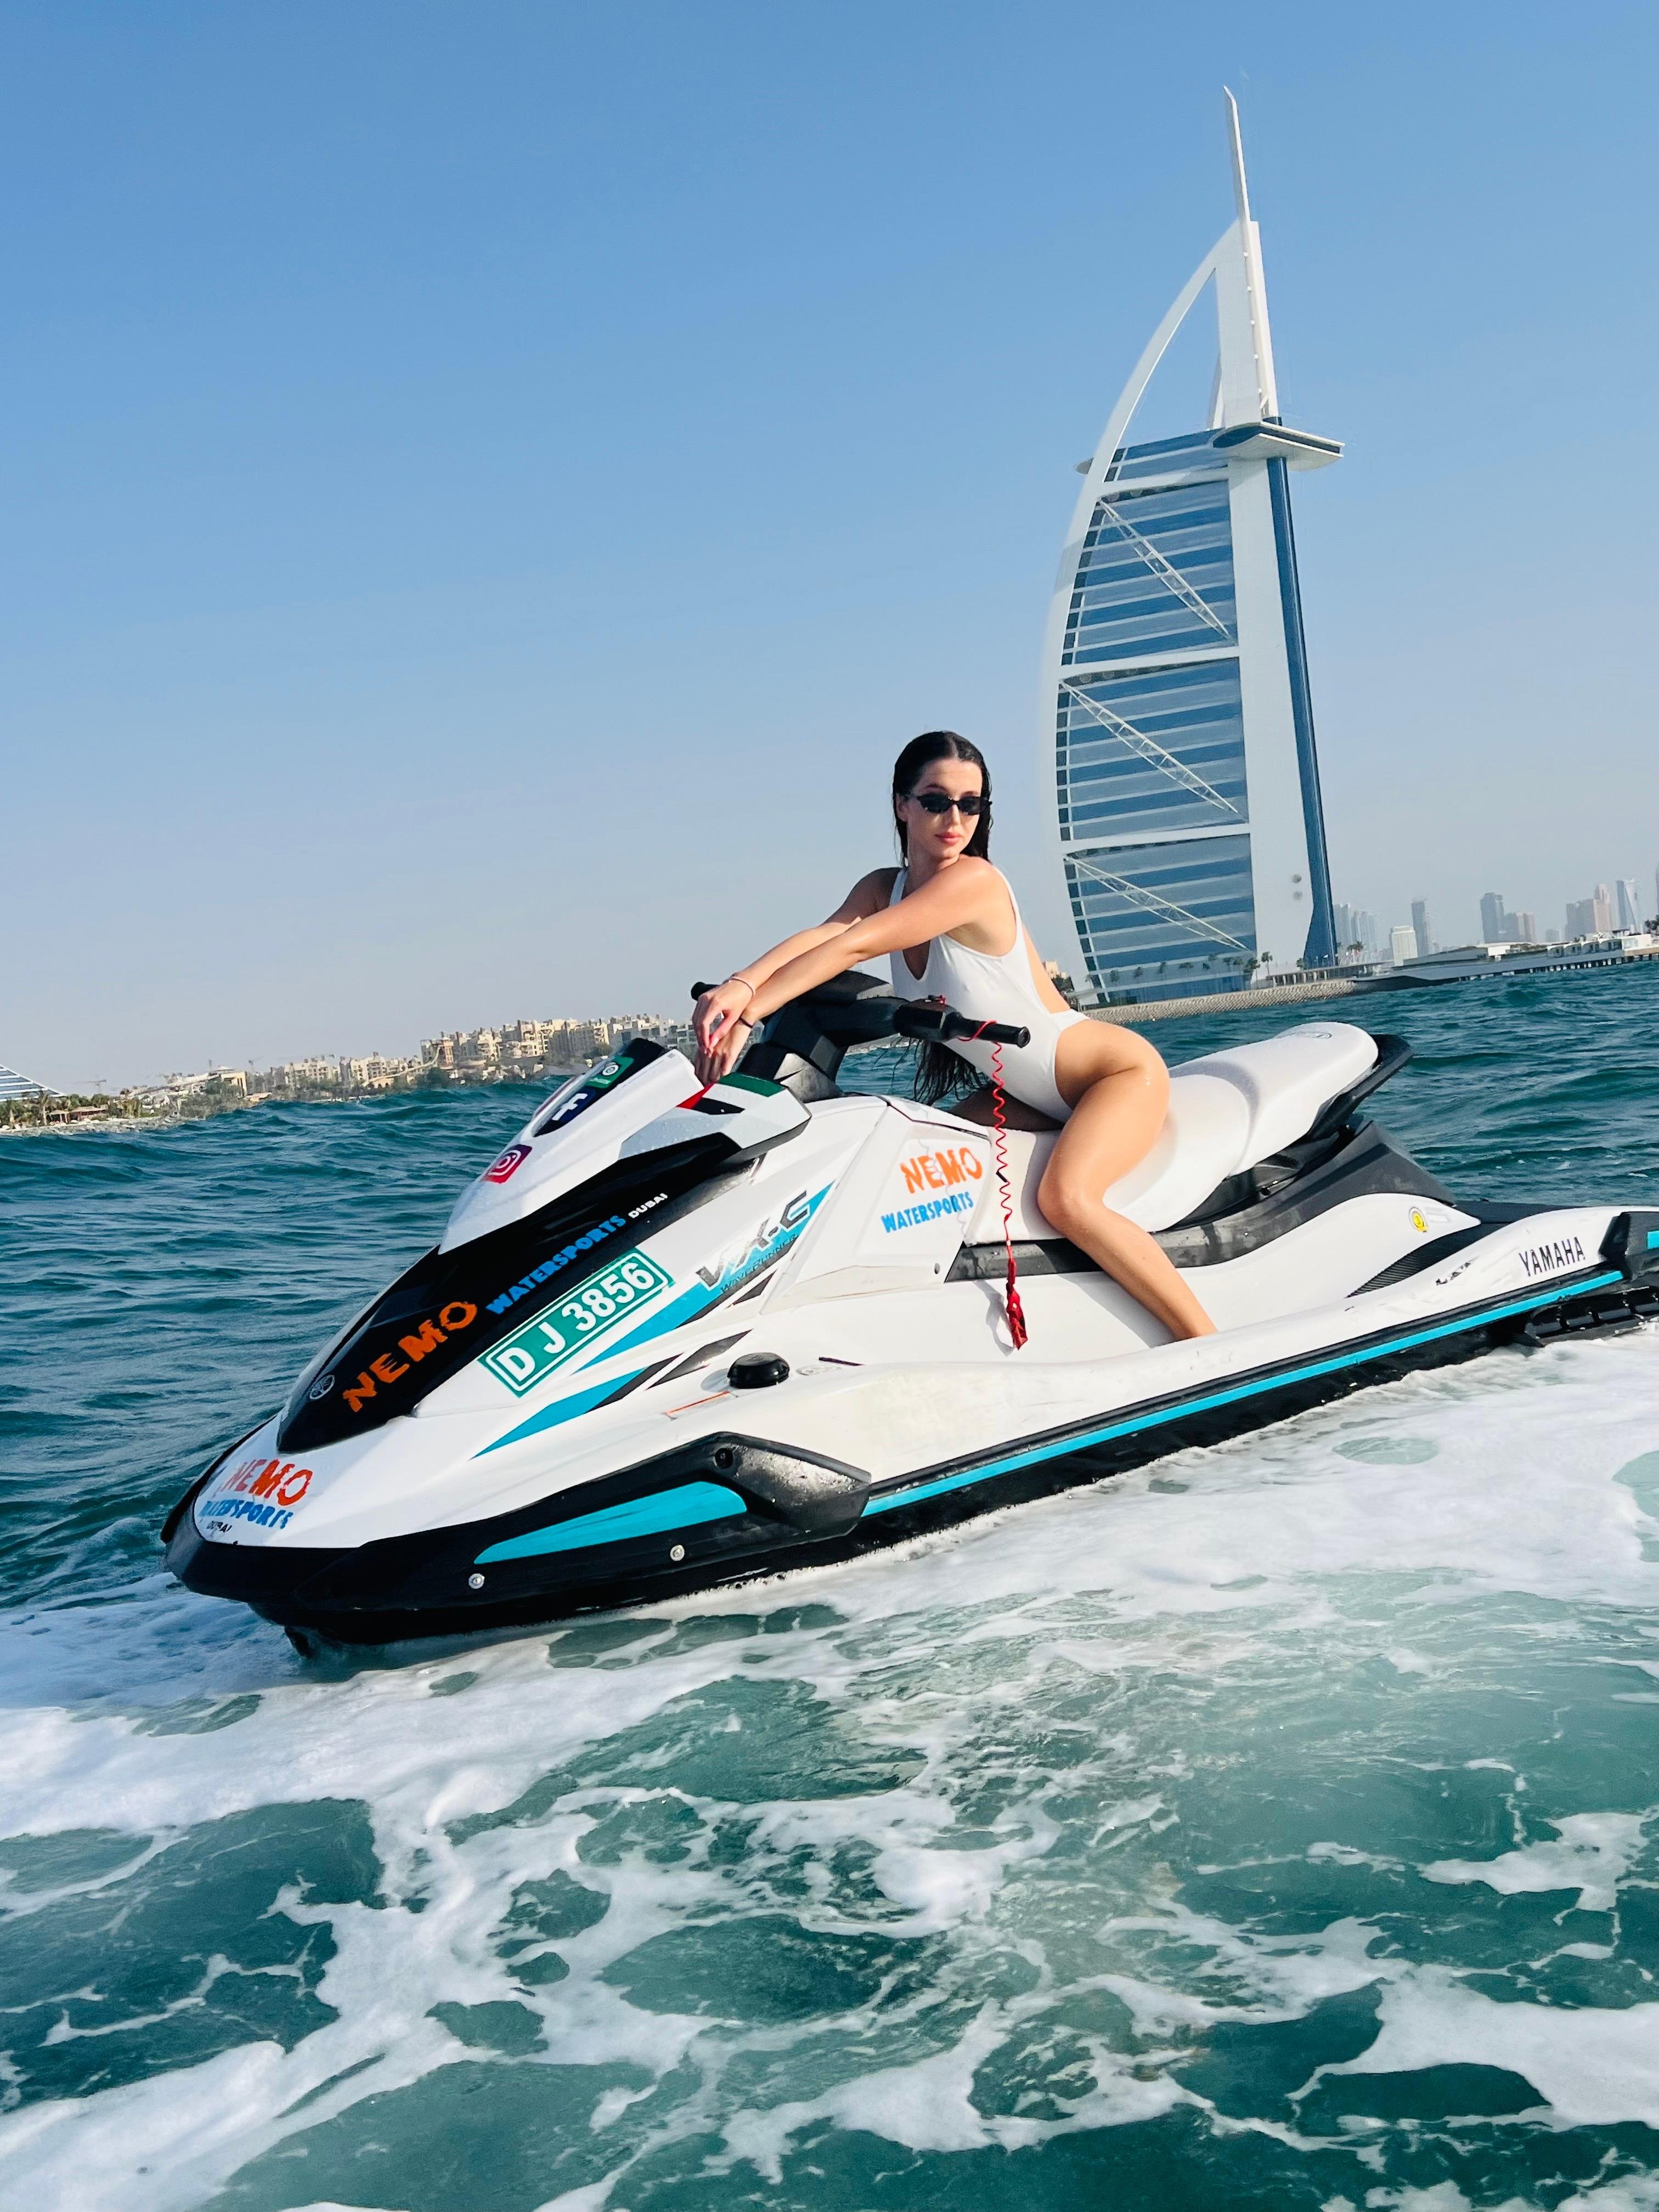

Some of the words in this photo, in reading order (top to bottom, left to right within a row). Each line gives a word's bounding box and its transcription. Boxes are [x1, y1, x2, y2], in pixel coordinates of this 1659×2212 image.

[900, 1146, 983, 1194] NEMO
[881, 1191, 974, 1233] WATERSPORTS
[1519, 1237, 1586, 1277] YAMAHA
[342, 1301, 478, 1413] NEMO
[486, 1215, 627, 1314] WATERSPORTS
[628, 1192, 668, 1219] DUBAI
[496, 1346, 536, 1382] D
[543, 1322, 566, 1353] J
[561, 1262, 655, 1332] 3856
